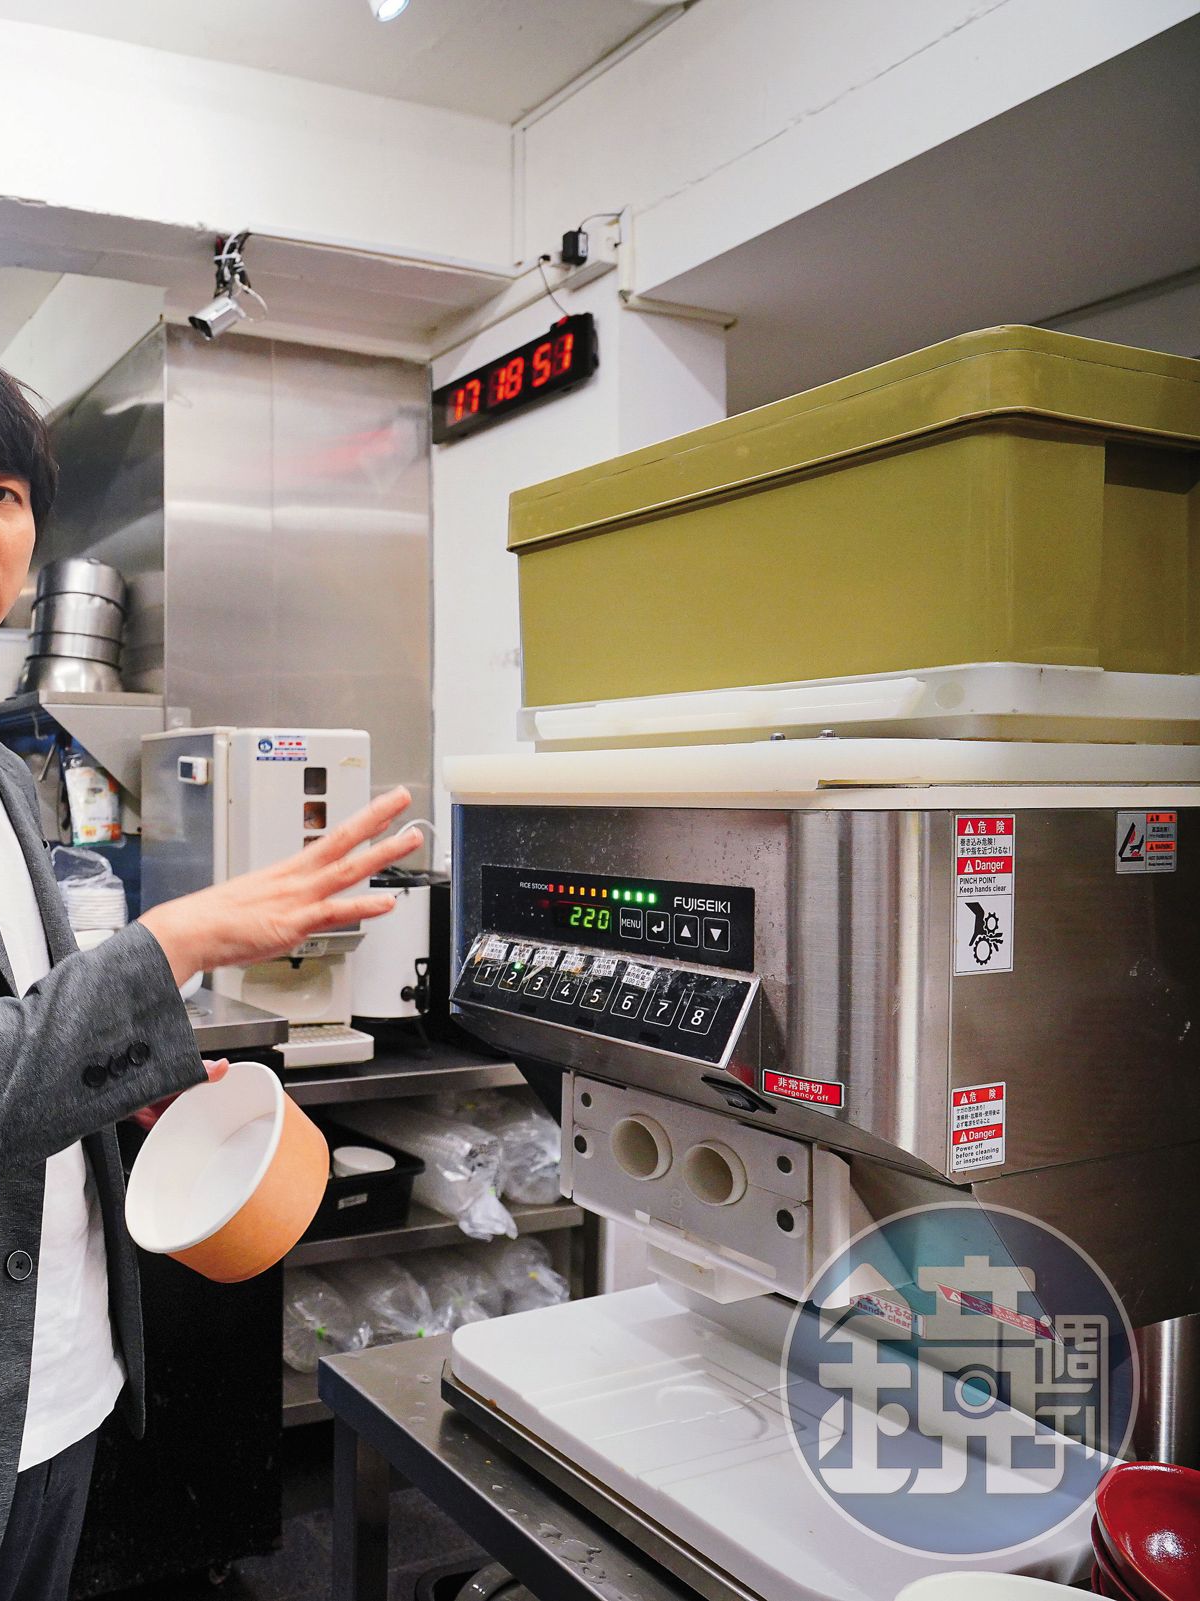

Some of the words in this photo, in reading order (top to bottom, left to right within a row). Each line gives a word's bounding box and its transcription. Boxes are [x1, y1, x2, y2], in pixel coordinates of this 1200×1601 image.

[455, 378, 481, 421] 17
[496, 356, 524, 401] 18
[532, 333, 574, 388] 51
[977, 820, 1005, 834] 危険
[975, 859, 1005, 873] Danger
[531, 883, 549, 891] STOCK
[960, 877, 977, 885] PINCH
[978, 876, 996, 884] POINT
[960, 886, 974, 894] Keep
[975, 885, 992, 893] hands
[993, 884, 1007, 892] clear
[673, 896, 731, 914] FUJISEIKI
[569, 906, 610, 930] 220
[621, 918, 641, 929] MENU
[484, 966, 492, 979] 1
[507, 971, 518, 985] 2
[532, 976, 544, 991] 3
[560, 982, 570, 997] 4
[590, 987, 602, 1003] 5
[621, 995, 634, 1010] 6
[656, 1001, 669, 1017] 7
[690, 1009, 705, 1026] 8
[773, 1085, 814, 1100] Emergency
[777, 1077, 823, 1094] 非常時切
[969, 1129, 996, 1140] Danger
[956, 1151, 974, 1159] before
[976, 1147, 1000, 1156] cleaning
[963, 1154, 993, 1165] inspection
[887, 1314, 912, 1329] clear
